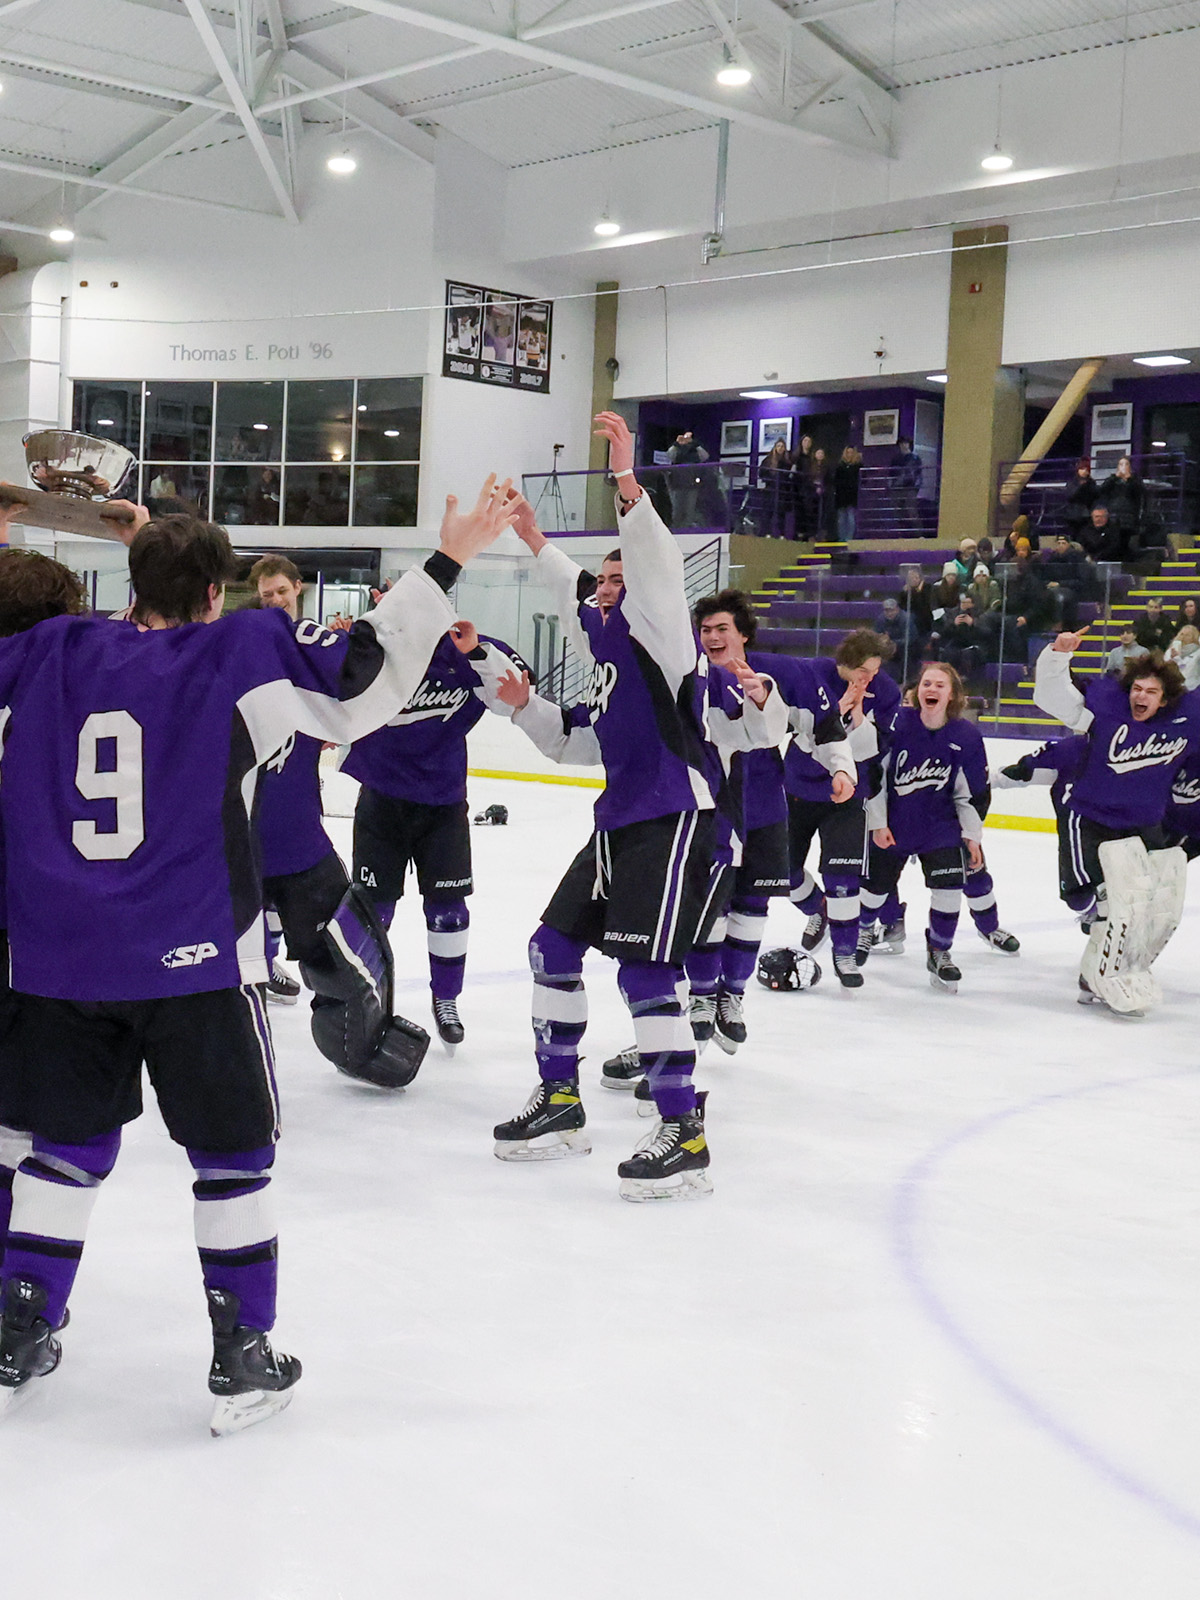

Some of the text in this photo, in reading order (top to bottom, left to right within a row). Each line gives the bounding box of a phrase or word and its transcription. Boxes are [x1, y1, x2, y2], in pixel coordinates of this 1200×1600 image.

[169, 344, 237, 361] Thomas
[245, 345, 259, 360] E.
[308, 342, 334, 359] '96
[1108, 724, 1188, 765] Cushing
[72, 710, 145, 860] 9
[894, 750, 952, 791] Cushing
[360, 866, 378, 887] CA
[604, 931, 651, 945] BAUER
